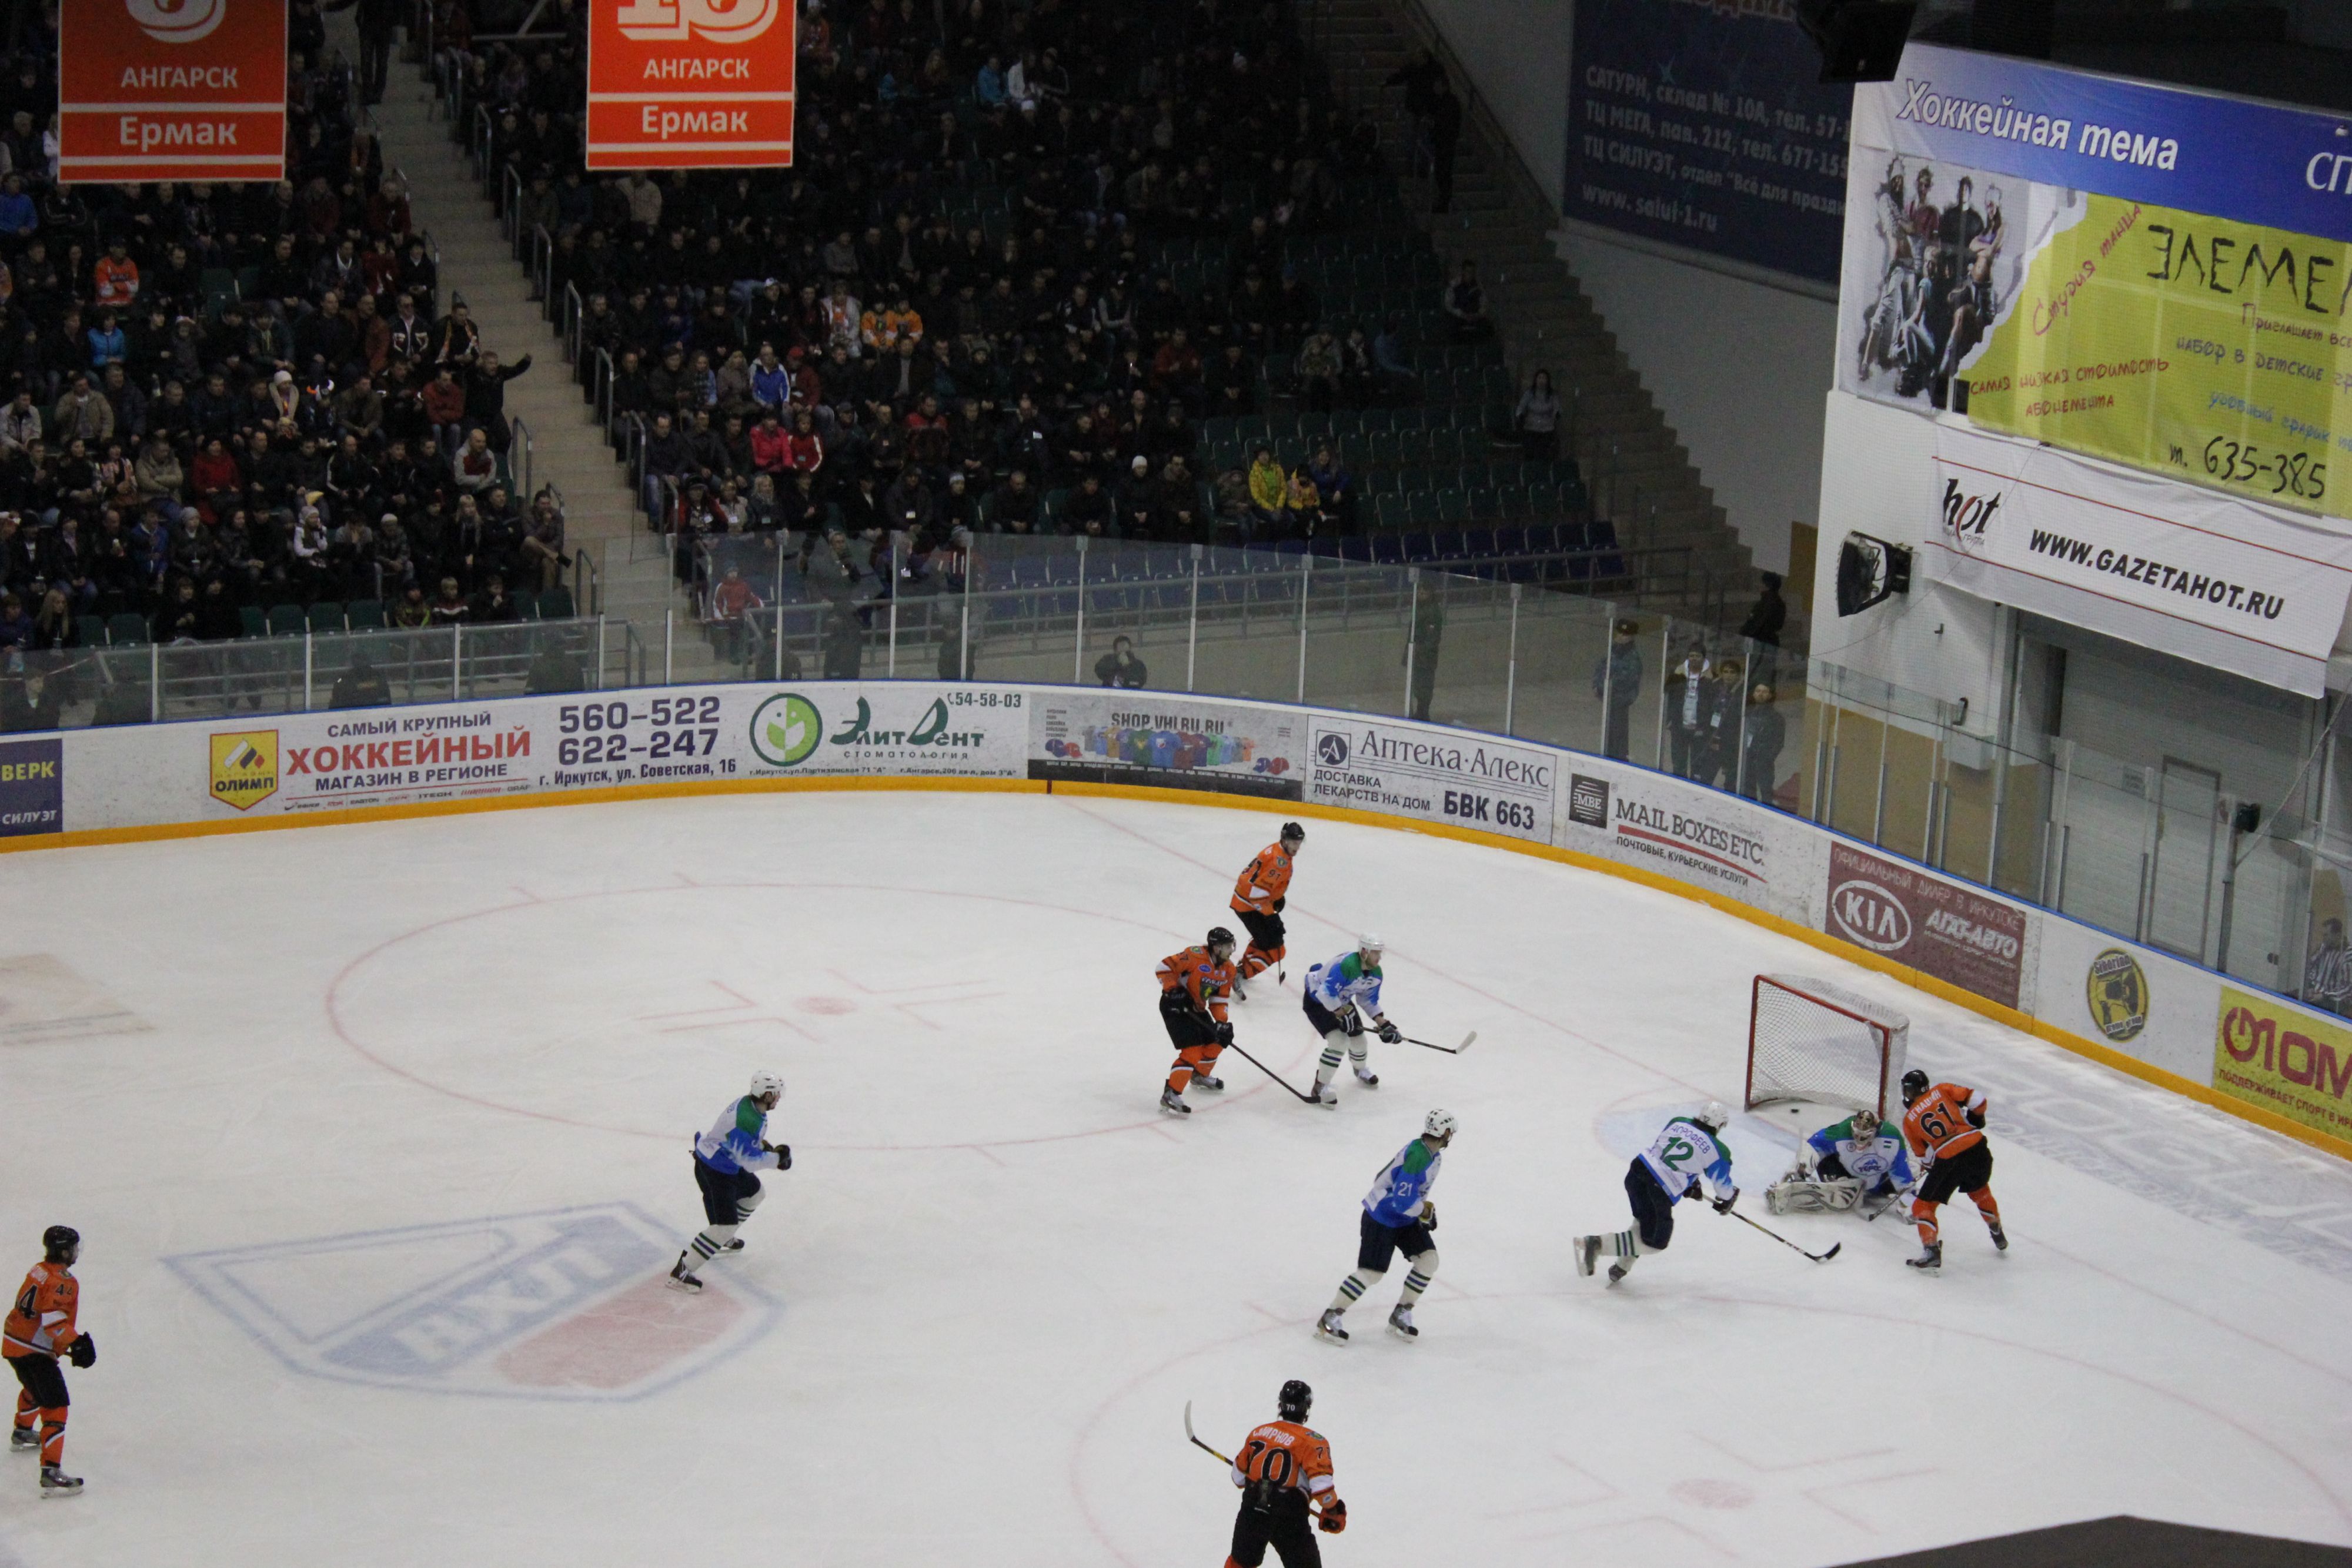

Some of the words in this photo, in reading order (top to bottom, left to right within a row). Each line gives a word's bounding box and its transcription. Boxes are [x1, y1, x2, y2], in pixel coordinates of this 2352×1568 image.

[121, 66, 238, 89] АНГАРСК
[644, 58, 749, 79] АНГАРСК
[1585, 66, 1651, 101] САТУРН,
[120, 116, 237, 152] Ермак
[642, 105, 748, 139] Ермак
[1585, 100, 1606, 126] ТЦ
[1609, 106, 1656, 139] МЕГА,
[1898, 79, 2073, 149] Хоккейная
[2078, 121, 2180, 171] тема
[1583, 135, 1605, 164] ТЦ
[1608, 141, 1676, 180] СИЛУЭТ,
[2307, 152, 2352, 195] СП
[1970, 379, 2011, 395] САМАЯ
[2020, 372, 2069, 389] НИЗКАЯ
[2076, 357, 2169, 381] СТОИМОСТЬ
[2025, 395, 2114, 417] АБОНЕМЕНТА
[2204, 435, 2327, 500] 635-385
[1943, 478, 2002, 540] hot
[2029, 529, 2286, 620] WWW.GAZETAHOT.RU
[559, 696, 720, 734] 560-522
[955, 691, 1022, 708] 54-58-03
[327, 717, 397, 739] САМЫЙ
[403, 710, 492, 732] КРУПНЫЙ
[286, 725, 531, 775] ХОККЕЙНЫЙ
[558, 727, 719, 765] 622-247
[844, 750, 969, 760] стоматология
[2, 761, 55, 782] ВЕРК
[215, 777, 275, 793] ОЛИМП
[315, 771, 402, 792] МАГАЗИН
[407, 768, 420, 783] В
[425, 763, 508, 783] РЕГИОНЕ
[539, 774, 550, 786] г.
[554, 768, 612, 788] Иркутск,
[616, 765, 636, 781] ул.
[640, 762, 715, 780] Советская,
[719, 758, 736, 774] 16
[1314, 768, 1382, 788] ДОСТАВКА
[1313, 783, 1380, 804] ЛЕКАРСТВ
[1382, 792, 1400, 805] НА
[1402, 795, 1431, 812] ДОМ
[1444, 790, 1489, 822] БВК
[1495, 799, 1535, 831] 663
[1577, 791, 1603, 811] MBE
[2, 810, 57, 825] СИЛУЭТ
[1616, 798, 1669, 832] MAIL
[1672, 813, 1729, 852] BOXES
[1268, 868, 1281, 880] 91
[1616, 835, 1667, 860] ПОЧТОВЫЕ,
[1668, 850, 1719, 877] КУРЬЕРСКИЕ
[1719, 867, 1750, 887] УСЛУГИ
[1834, 847, 1912, 888] ОФИЦИАЛЬНЫЙ
[1917, 881, 1952, 904] ДИЛЕР
[1956, 894, 1965, 910] В
[1845, 891, 1898, 941] KIA
[2219, 1068, 2295, 1106] ПОДДЕРЖИВАЕТ
[2296, 1098, 2327, 1119] СПОРТ
[2328, 1108, 2336, 1122] В
[1919, 1101, 1957, 1140] 61
[1660, 1136, 1694, 1172] 12
[1671, 1124, 1711, 1155] ДОРОФЕЕВ
[1397, 1181, 1414, 1198] 21
[1285, 1403, 1296, 1412] 70
[1247, 1439, 1293, 1487] 70
